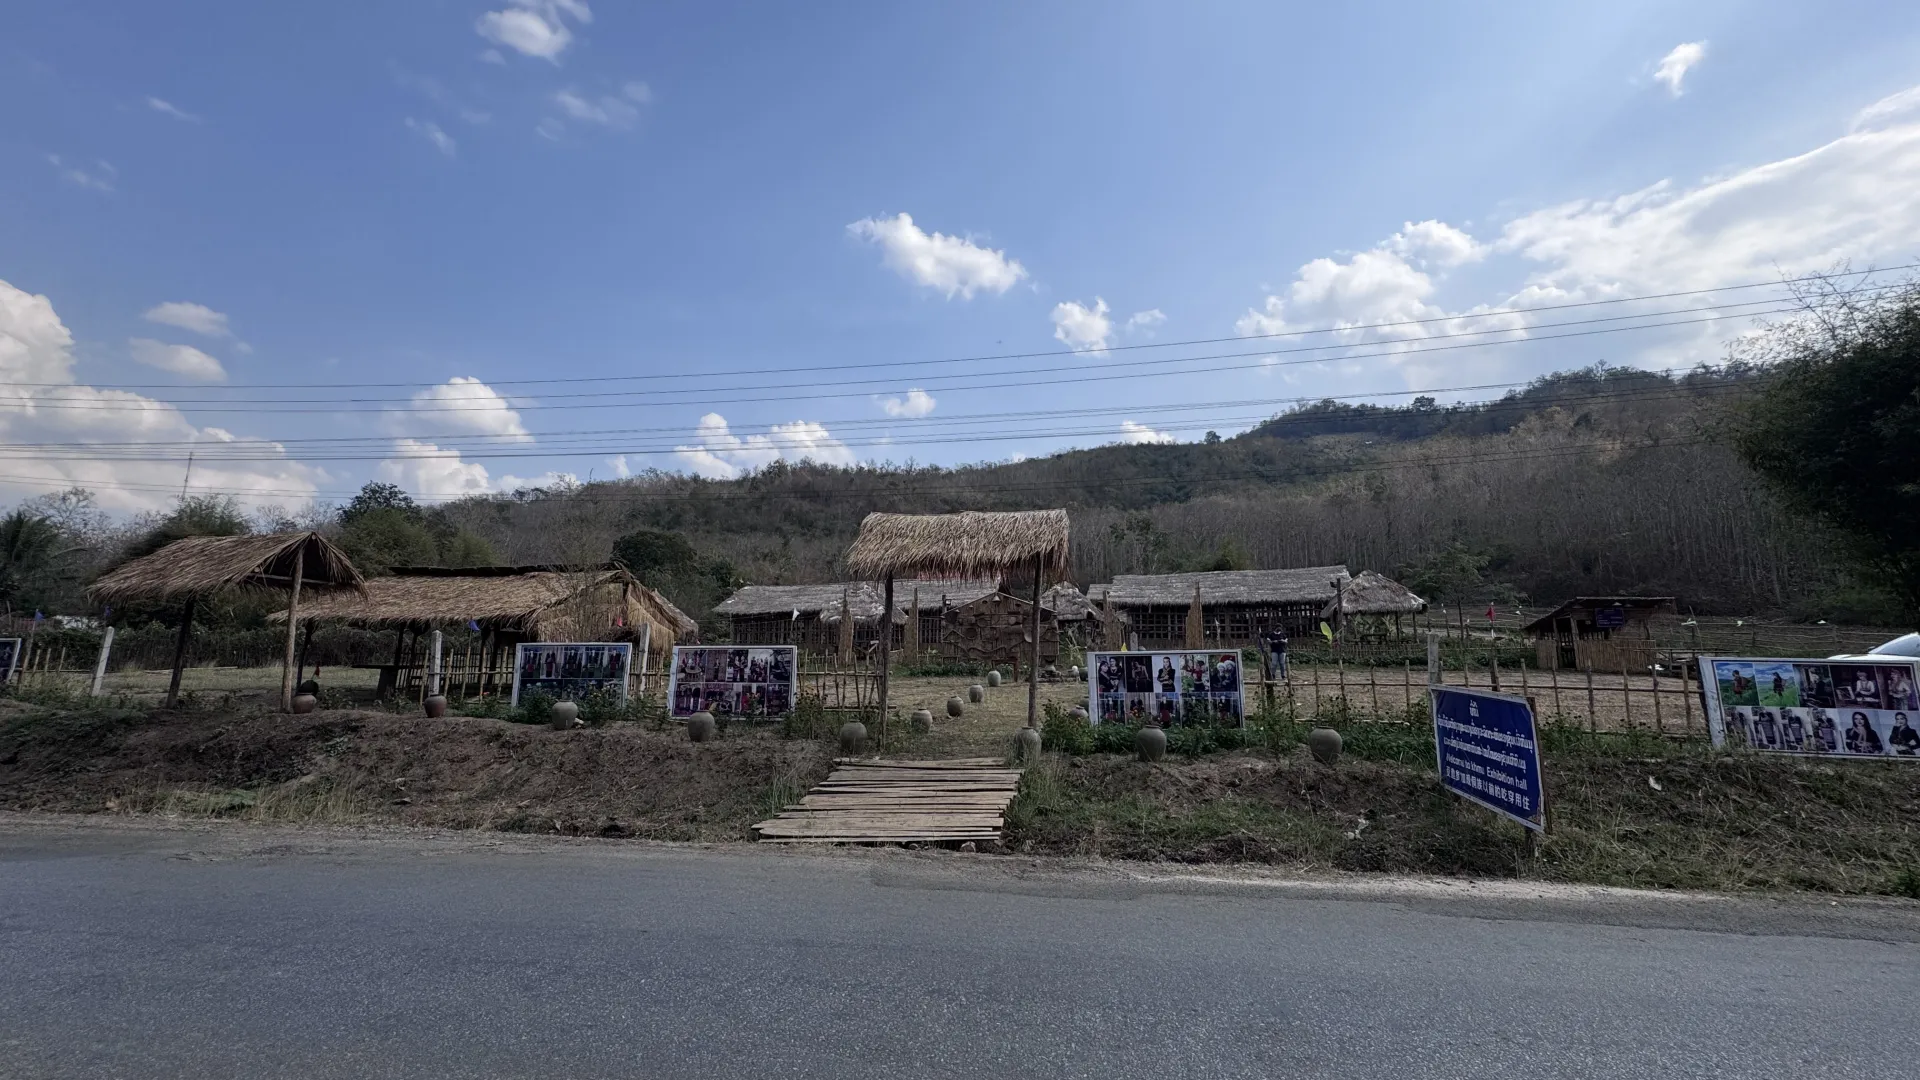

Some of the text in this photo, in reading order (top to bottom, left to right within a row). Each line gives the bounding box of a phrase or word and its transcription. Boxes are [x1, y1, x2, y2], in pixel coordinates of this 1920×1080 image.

[1465, 759, 1471, 770] to
[1486, 766, 1514, 786] Exhibition
[1515, 776, 1528, 791] hall
